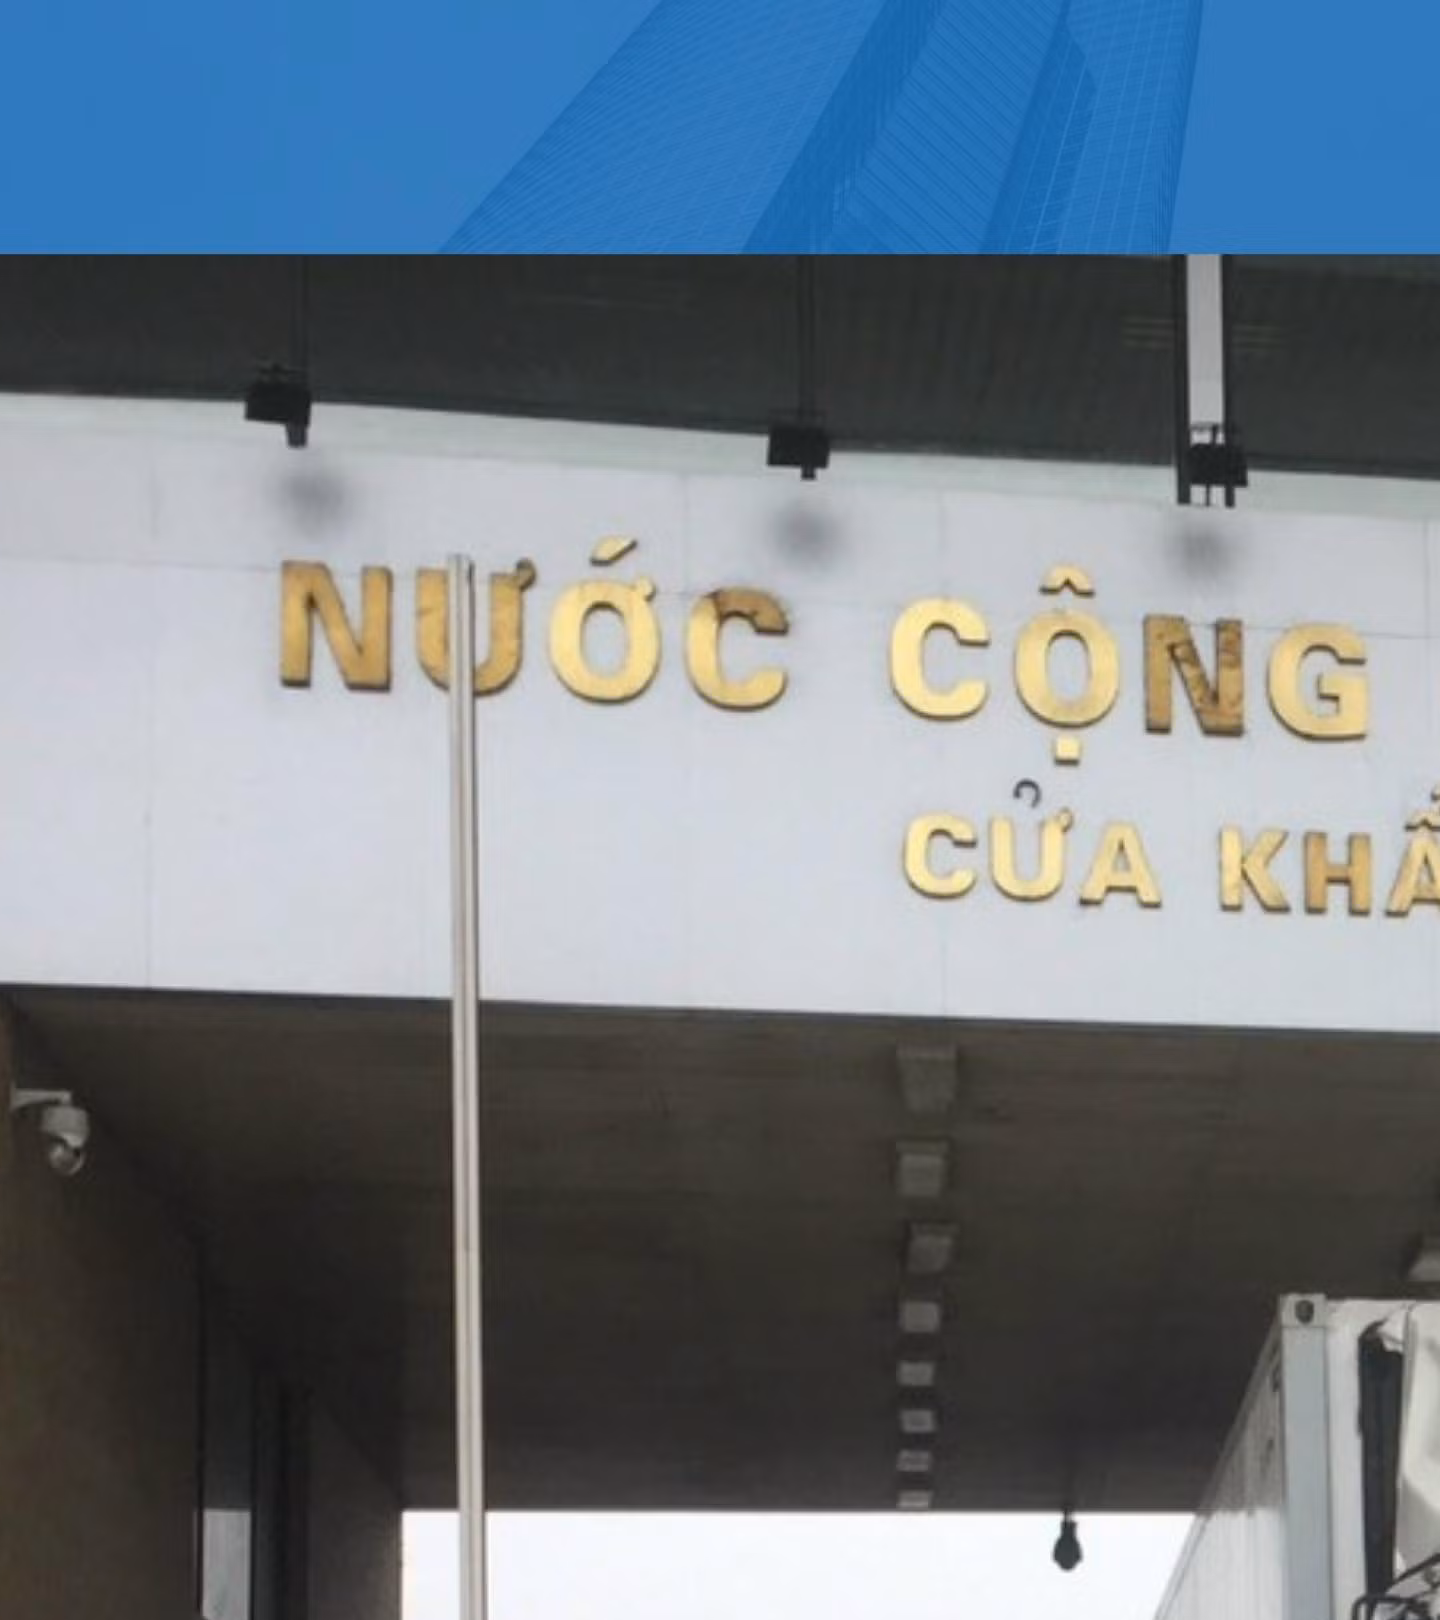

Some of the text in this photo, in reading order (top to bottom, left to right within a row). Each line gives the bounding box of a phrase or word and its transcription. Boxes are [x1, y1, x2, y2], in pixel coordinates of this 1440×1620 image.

[279, 536, 789, 711] NƯỚC
[888, 565, 1370, 765] CỘNG
[901, 778, 1164, 909] CỬA
